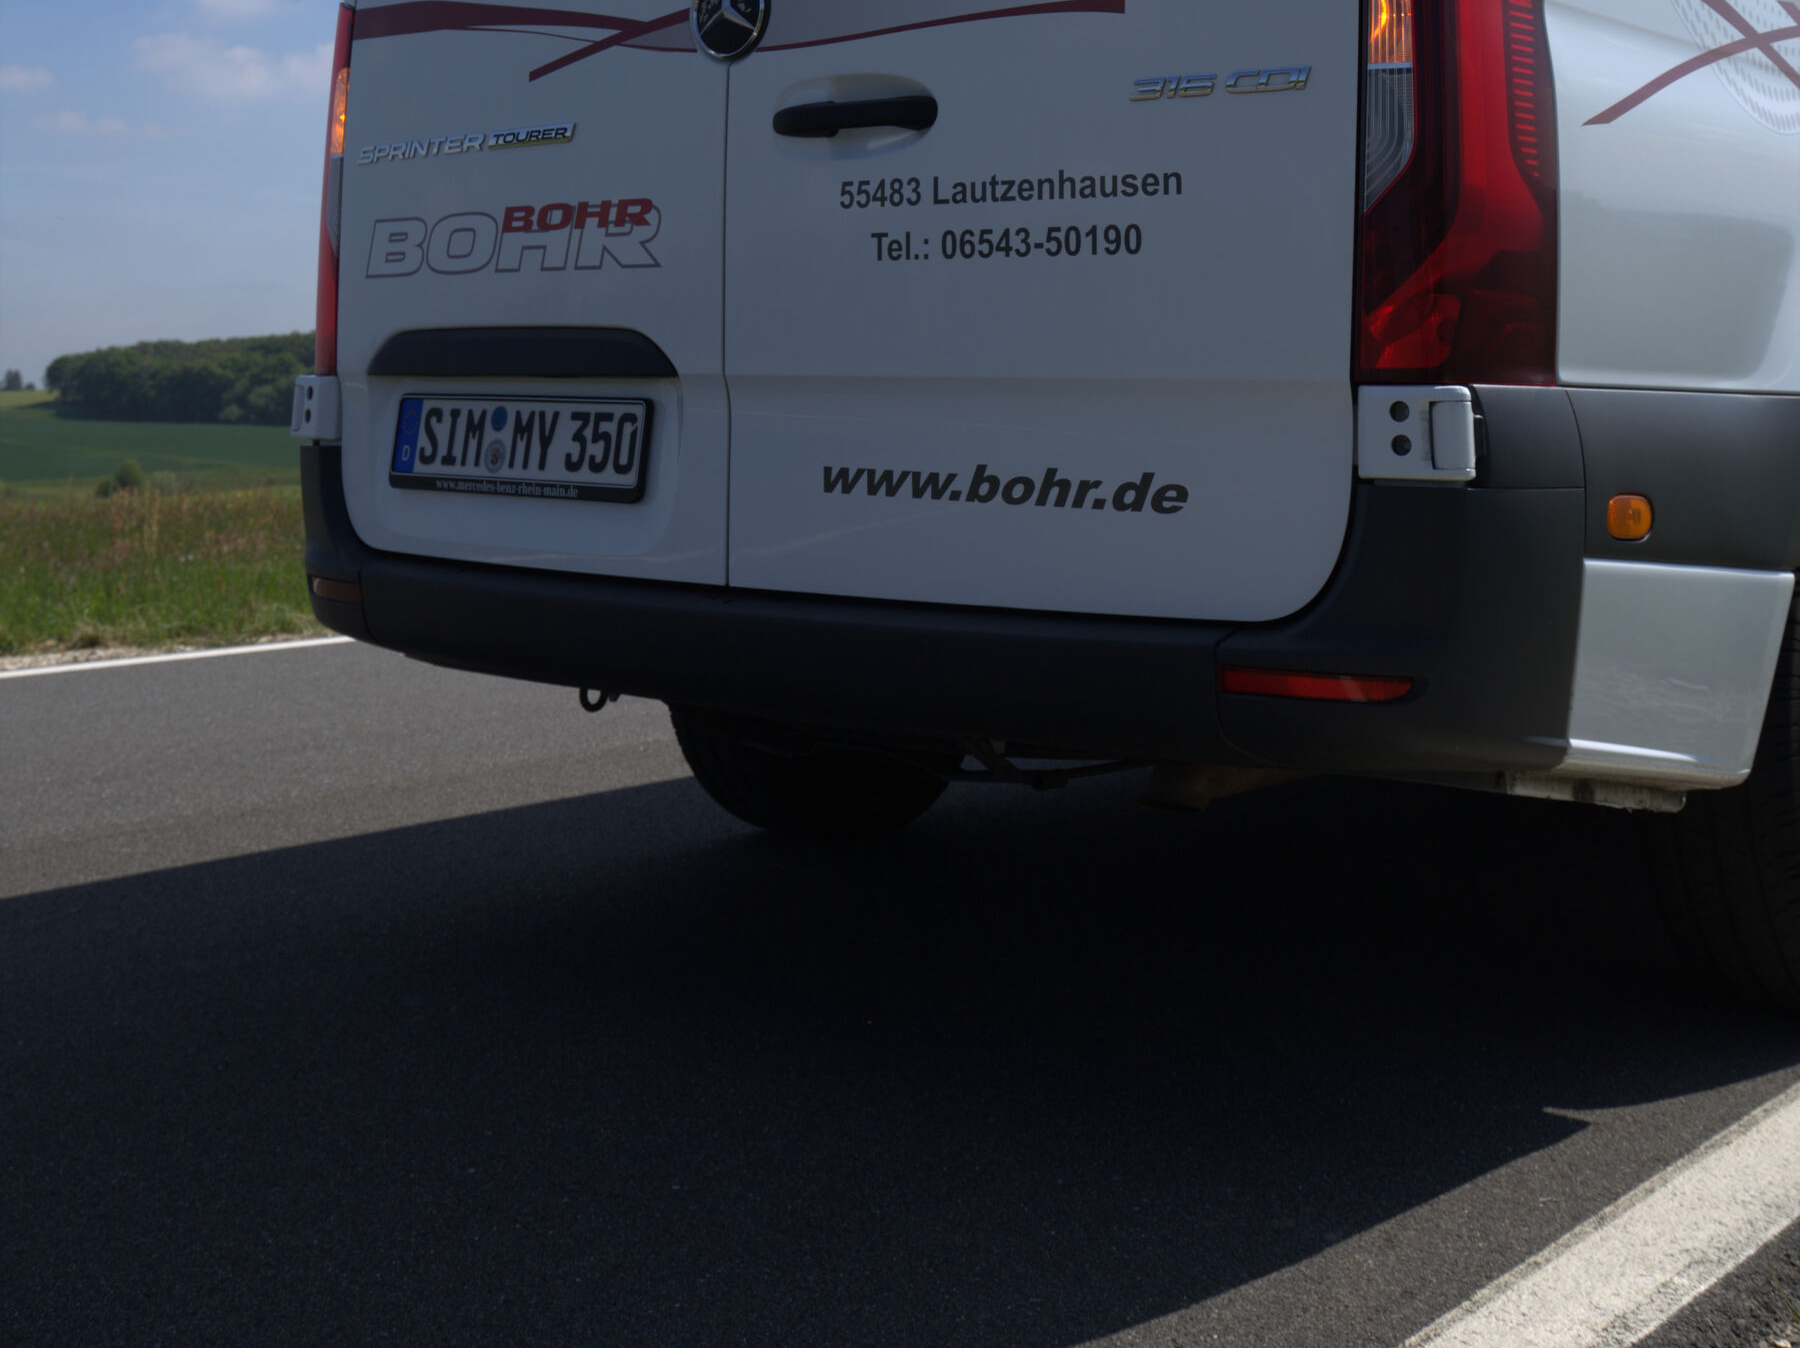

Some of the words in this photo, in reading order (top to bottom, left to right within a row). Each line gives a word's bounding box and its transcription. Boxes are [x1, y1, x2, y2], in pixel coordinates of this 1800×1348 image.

[1225, 65, 1312, 94] CDI
[357, 132, 486, 165] SPRINTER
[493, 127, 569, 145] TOURER
[839, 177, 922, 209] 55483
[932, 170, 1183, 205] Lautzenhausen
[501, 198, 653, 234] BOHR
[365, 204, 662, 279] BOHR
[871, 230, 930, 261] Tel.:
[941, 224, 1142, 259] 06543-50190
[401, 445, 411, 462] D
[418, 407, 487, 467] SIM
[508, 410, 560, 471] MY
[564, 412, 639, 475] 350
[822, 464, 1189, 515] www.bohr.de
